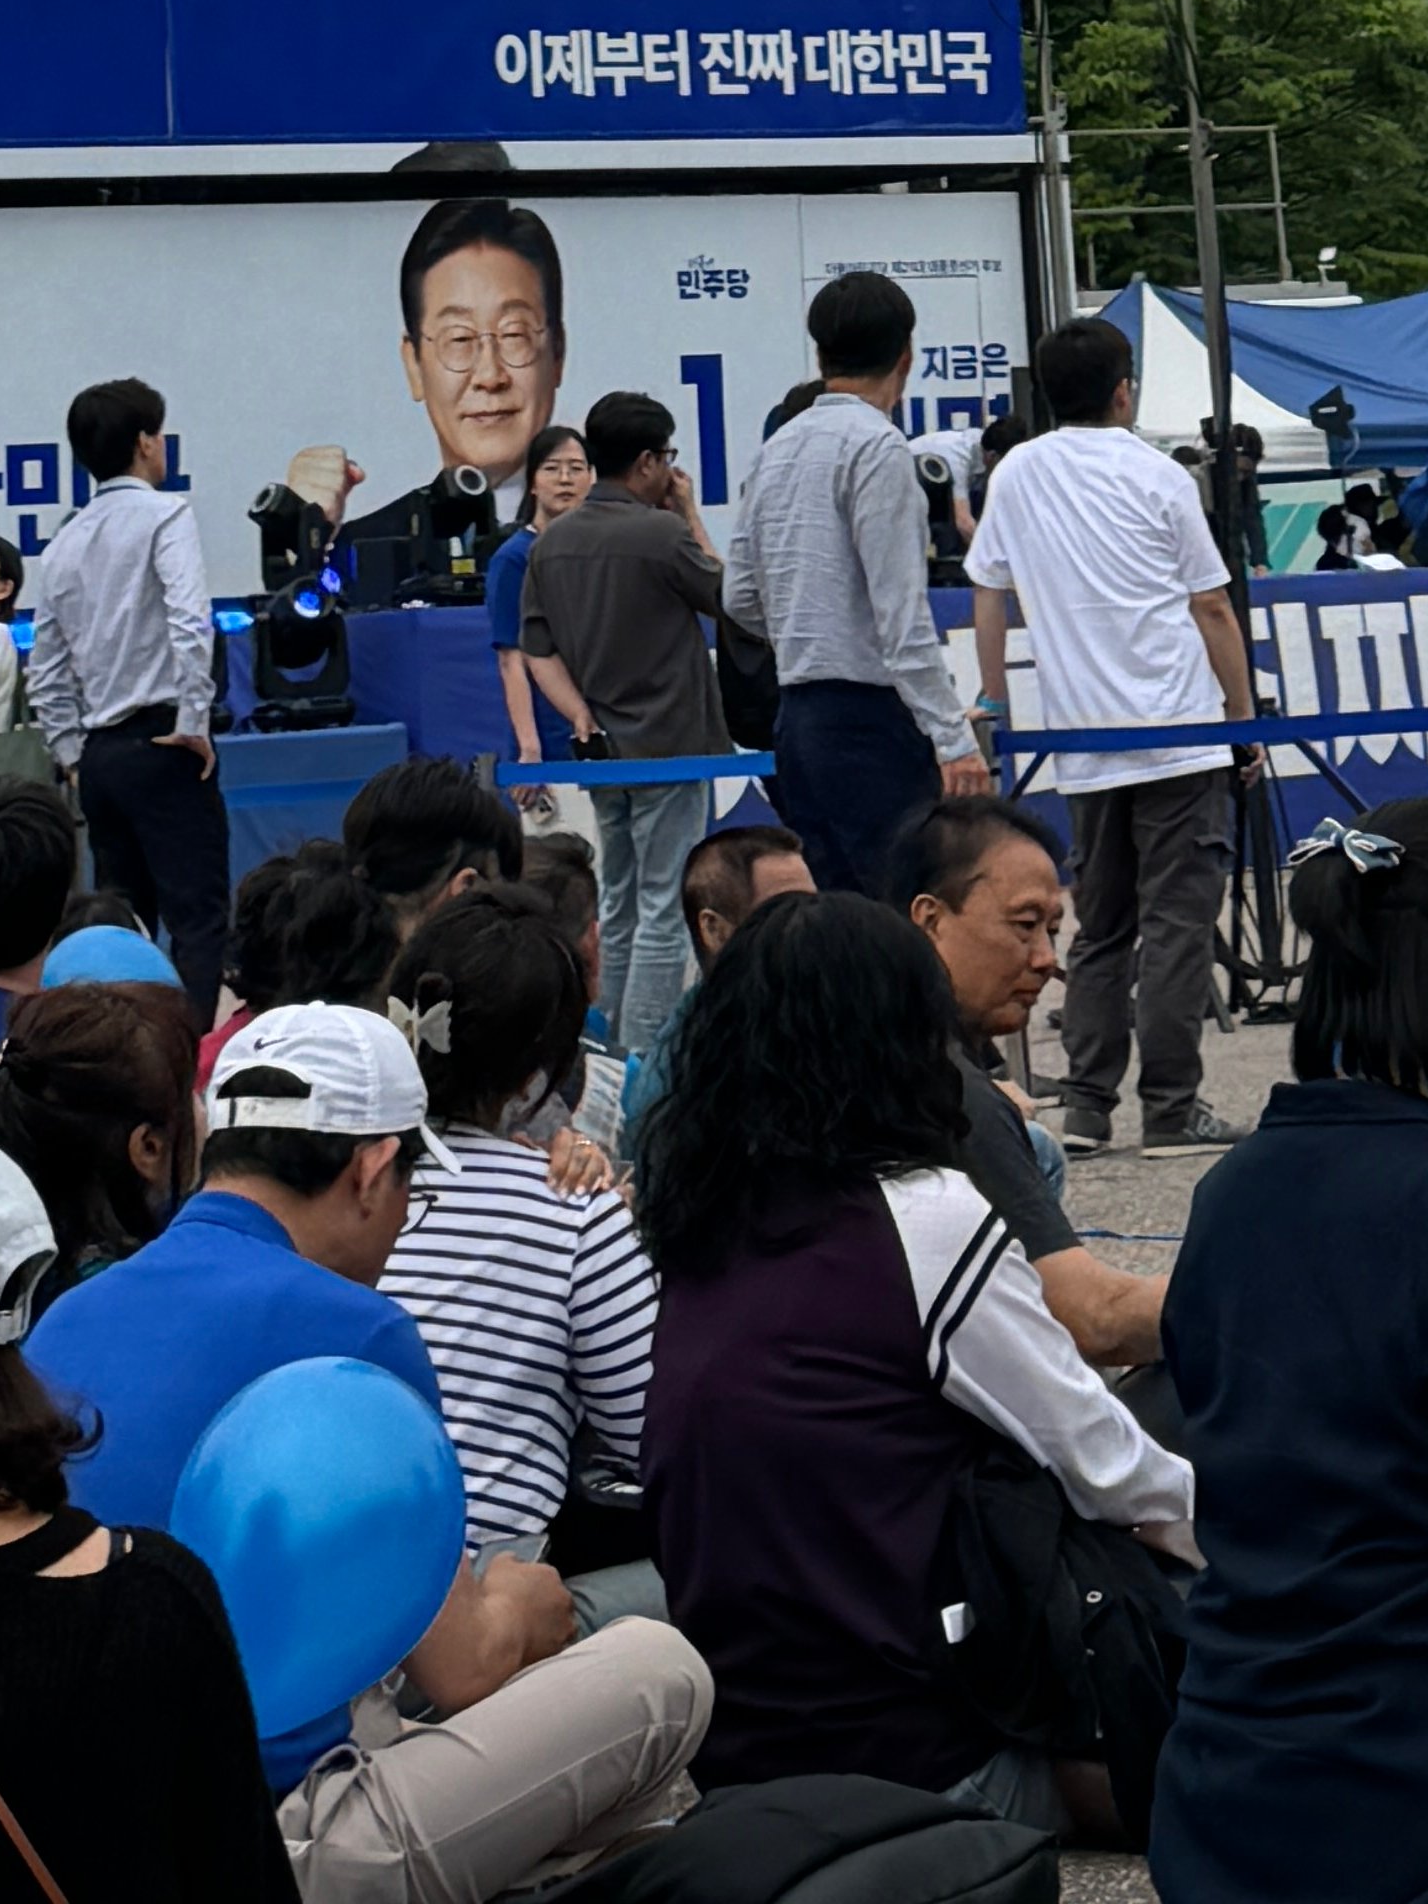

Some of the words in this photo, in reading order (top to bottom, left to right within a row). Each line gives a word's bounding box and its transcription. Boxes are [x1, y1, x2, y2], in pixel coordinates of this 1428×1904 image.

[494, 27, 691, 100] 이제부터
[698, 28, 798, 97] 진짜
[803, 28, 993, 97] 대한민국
[676, 268, 750, 300] 민주당
[922, 342, 1009, 380] 지금은
[679, 353, 729, 507] 1
